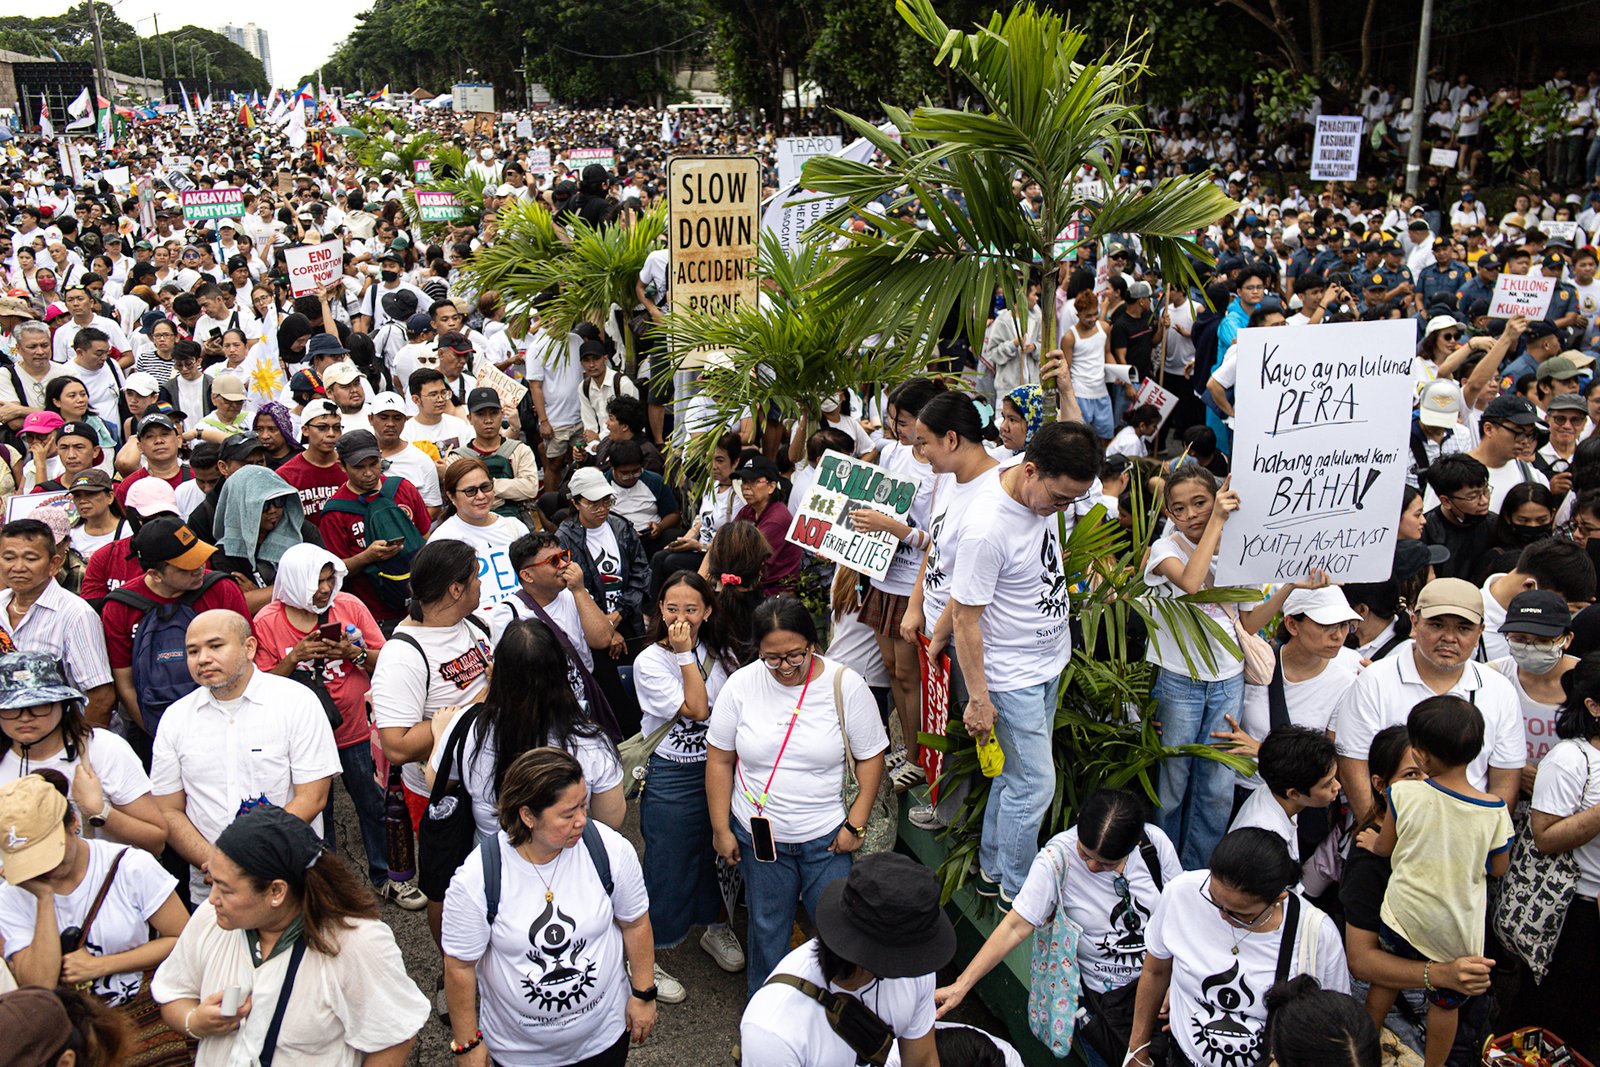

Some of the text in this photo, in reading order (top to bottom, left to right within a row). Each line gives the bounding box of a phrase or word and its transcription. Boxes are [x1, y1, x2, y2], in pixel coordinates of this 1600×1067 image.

[184, 190, 242, 205] AKBAYAN
[681, 172, 747, 205] SLOW
[185, 203, 243, 218] PARTYLIST
[679, 215, 751, 250] DOWN
[292, 257, 342, 276] CORRUPTION
[308, 248, 332, 264] END
[677, 258, 753, 285] ACCIDENT
[689, 293, 741, 318] PRONE
[1496, 303, 1543, 317] KURAKOT
[1260, 342, 1307, 390] Kayo
[1312, 362, 1333, 386] ay
[1310, 380, 1327, 392] sa
[1271, 382, 1360, 438] PERA
[1253, 443, 1313, 475] habang
[817, 455, 916, 515] TRILLIONS
[1311, 468, 1325, 480] sa
[1266, 466, 1382, 518] BAHA!
[791, 513, 833, 550] NOT
[844, 534, 891, 573] ELITES
[1239, 526, 1390, 566] YOUTH AGAINST
[1274, 554, 1360, 579] KURAKOT
[1093, 961, 1132, 976] Saving
